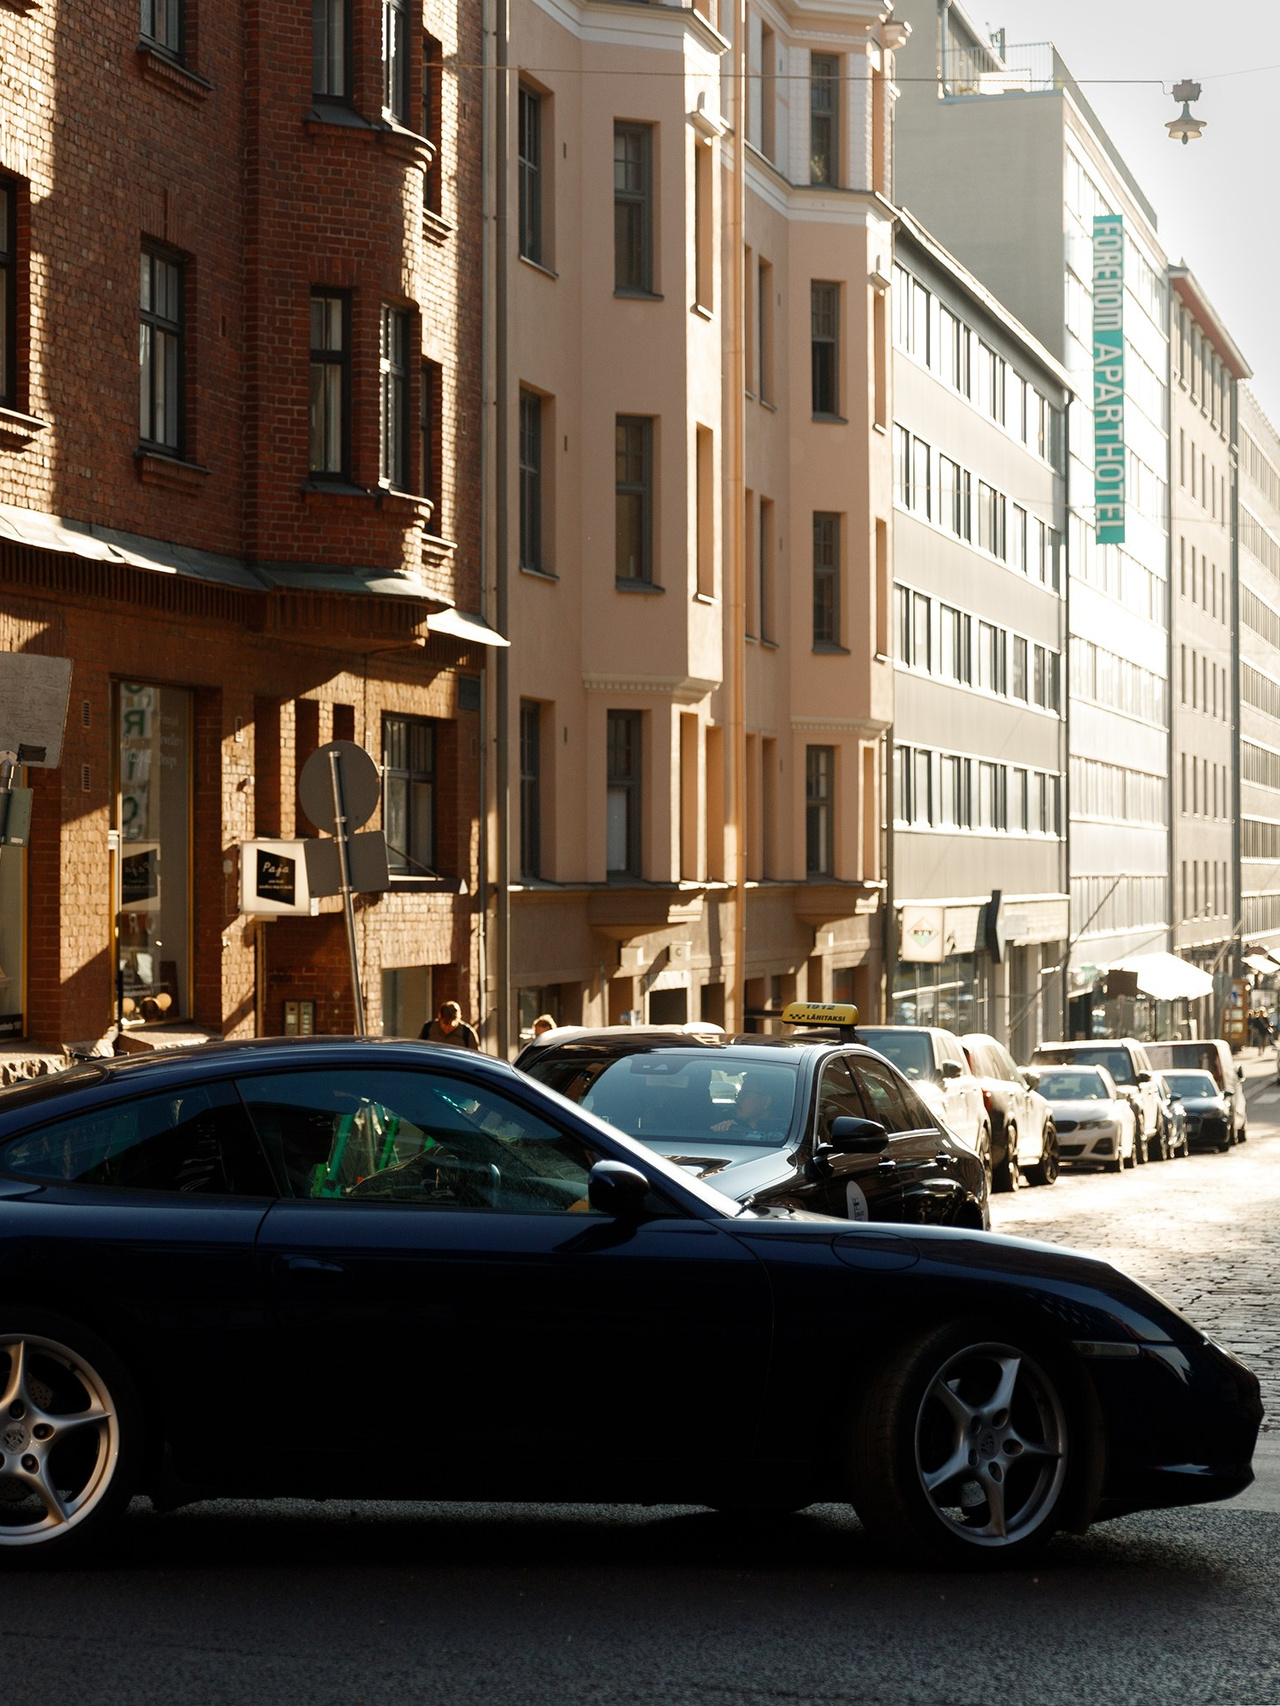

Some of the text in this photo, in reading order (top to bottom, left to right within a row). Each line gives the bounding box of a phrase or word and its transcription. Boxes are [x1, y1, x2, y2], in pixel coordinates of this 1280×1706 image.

[1094, 221, 1124, 537] FORENOM APARTHOTEL
[262, 861, 289, 877] Paja
[806, 1014, 846, 1022] LÄHITAKSI
